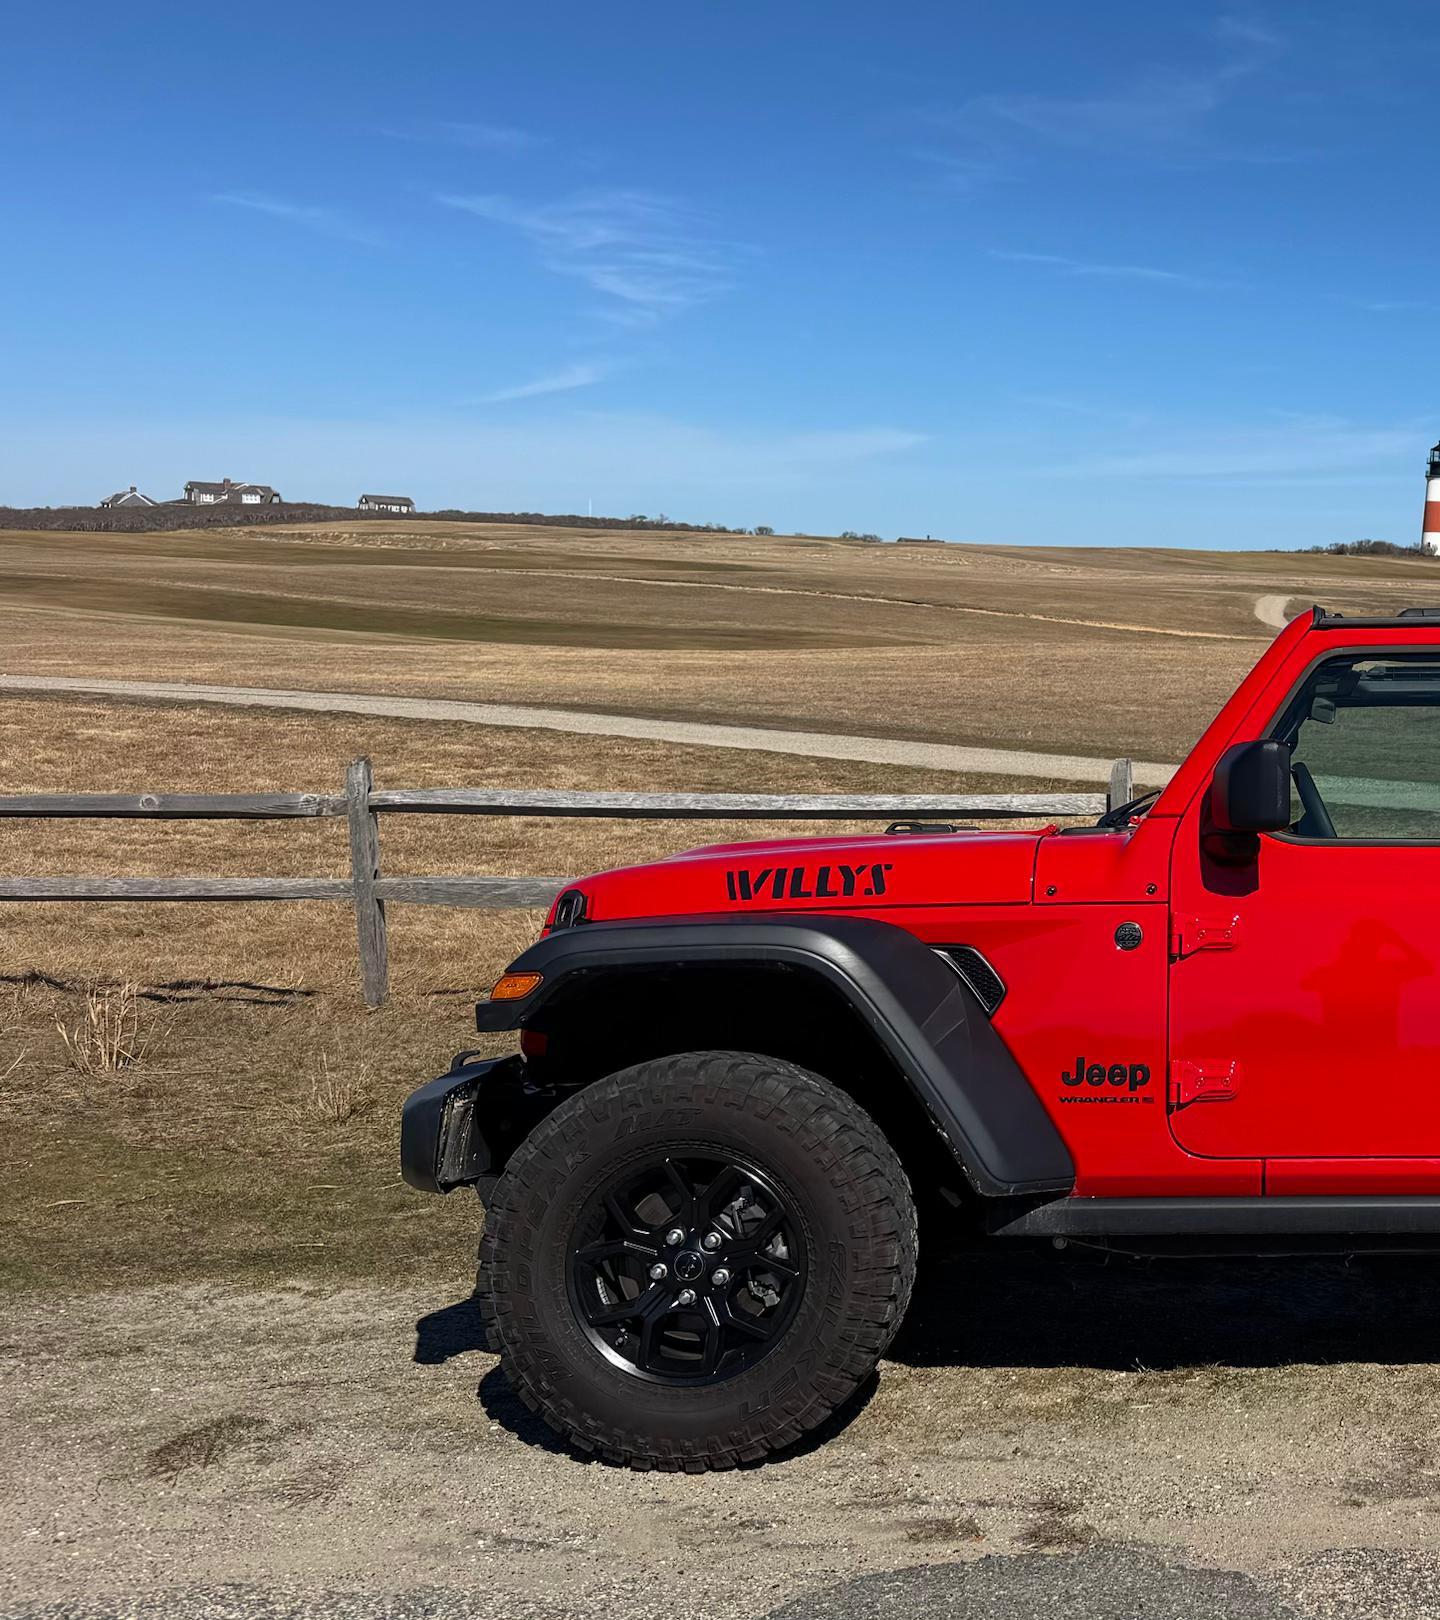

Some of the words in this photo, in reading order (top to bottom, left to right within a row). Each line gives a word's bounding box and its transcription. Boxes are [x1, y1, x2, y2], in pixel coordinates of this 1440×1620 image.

[726, 863, 893, 900] WILLYS
[1061, 1056, 1150, 1091] Jeep
[1059, 1096, 1139, 1104] WRANGLER
[510, 1145, 590, 1379] WILDPEAK
[613, 1108, 704, 1142] M/T
